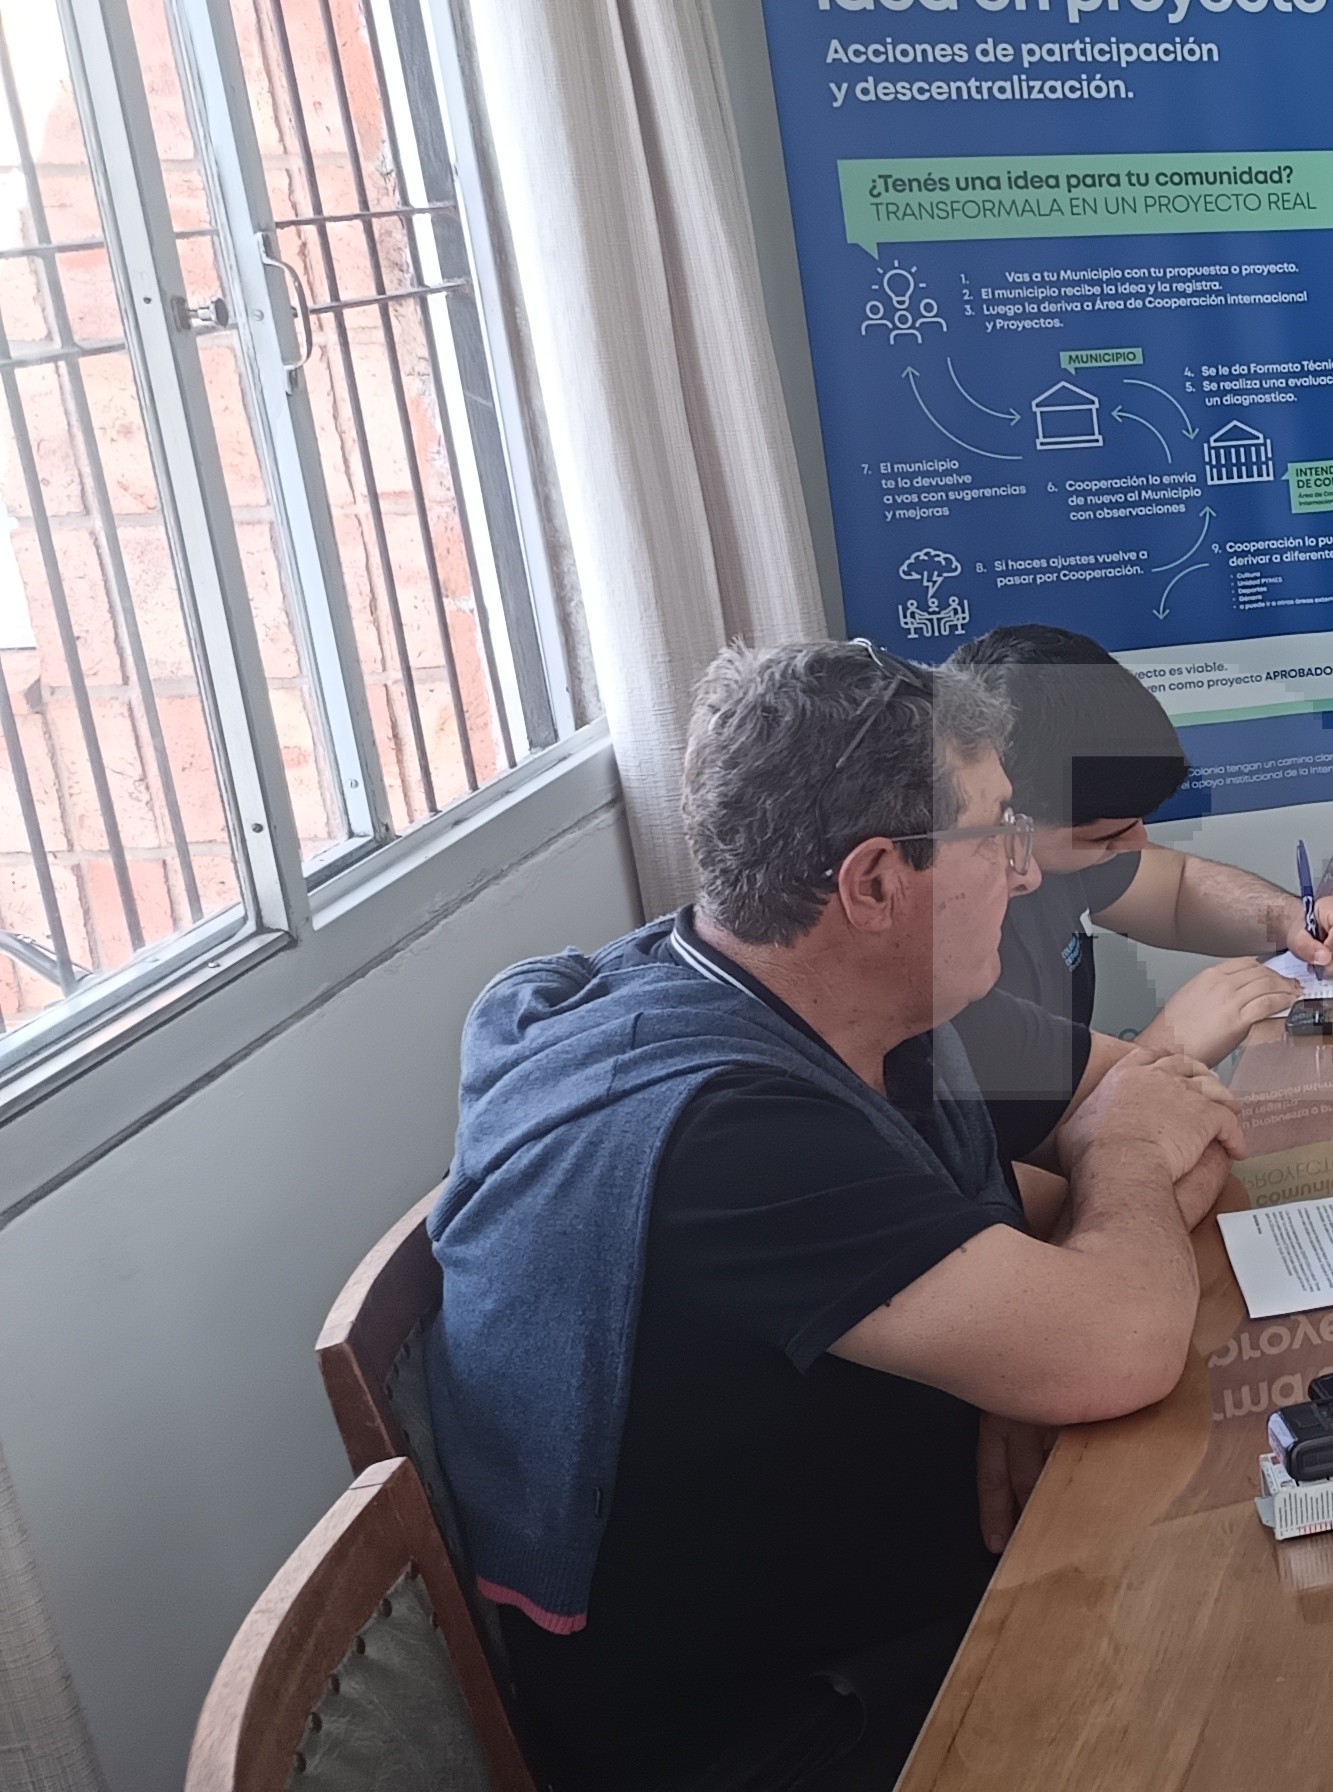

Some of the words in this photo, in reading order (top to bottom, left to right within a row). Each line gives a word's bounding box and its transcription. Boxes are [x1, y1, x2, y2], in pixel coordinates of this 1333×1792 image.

[825, 37, 969, 63] Acciones
[975, 37, 1014, 63] de
[1021, 37, 1219, 68] participación
[829, 82, 848, 107] y
[855, 74, 1134, 101] descentralización.
[869, 172, 950, 198] ¿Tenés
[955, 173, 1001, 191] una
[1007, 170, 1060, 190] idea
[1067, 171, 1120, 193] para
[1125, 169, 1150, 187] tu
[1155, 165, 1294, 187] comunidad?
[870, 199, 1065, 221] TRANSFORMALA
[1070, 197, 1098, 216] EN
[1104, 196, 1137, 215] UN
[1144, 193, 1262, 214] PROYECTO
[1268, 192, 1317, 210] REAL
[960, 273, 970, 284] 1.
[1005, 271, 1031, 283] Vas
[1032, 273, 1042, 282] a
[1043, 270, 1057, 281] tu
[1060, 267, 1123, 281] Municipio
[1124, 268, 1149, 278] con
[1150, 267, 1164, 277] tu
[1166, 265, 1229, 279] propuesta
[1231, 265, 1240, 274] o
[1241, 262, 1299, 276] proyecto.
[962, 289, 973, 300] 2.
[981, 288, 992, 299] El
[994, 285, 1059, 300] municipio
[1061, 282, 1101, 295] recibe
[1103, 283, 1116, 294] la
[1117, 282, 1146, 294] idea
[1148, 283, 1156, 295] y
[1157, 281, 1170, 292] la
[1172, 279, 1223, 294] registra.
[964, 305, 975, 316] 3.
[983, 302, 1023, 316] Luego
[1025, 301, 1038, 314] la
[1040, 299, 1081, 312] deriva
[1083, 302, 1092, 311] a
[1094, 296, 1125, 310] Área
[1126, 297, 1143, 309] de
[1145, 294, 1226, 309] Cooperación
[985, 321, 994, 333] y
[996, 316, 1064, 331] Proyectos.
[1068, 351, 1137, 365] MUNICIPIO
[1184, 366, 1194, 377] 4.
[1201, 365, 1216, 376] Se
[1218, 364, 1229, 375] le
[1231, 363, 1248, 375] da
[1250, 361, 1301, 374] Formato
[1185, 382, 1196, 392] 5.
[1202, 380, 1218, 391] Se
[1219, 378, 1260, 390] realiza
[1262, 378, 1286, 388] una
[1205, 396, 1221, 406] un
[1222, 391, 1298, 406] diagnostico.
[861, 464, 872, 475] 7.
[880, 462, 891, 474] El
[893, 458, 959, 473] municipio
[881, 478, 895, 489] te
[897, 477, 911, 488] lo
[912, 473, 972, 488] devuelve
[1047, 482, 1058, 492] 6.
[1065, 475, 1147, 492] Cooperación
[1148, 474, 1161, 485] lo
[1296, 479, 1313, 489] DE
[883, 495, 893, 504] a
[895, 493, 919, 503] vos
[921, 491, 946, 502] con
[948, 484, 1027, 501] sugerencias
[1068, 495, 1085, 506] de
[1087, 493, 1125, 504] nuevo
[1126, 489, 1139, 501] al
[1141, 487, 1202, 500] Municipio
[885, 510, 894, 522] y
[895, 505, 950, 520] mejoras
[1069, 510, 1094, 521] con
[1096, 503, 1186, 518] observaciones
[1212, 544, 1222, 554] 9.
[1226, 537, 1304, 553] Cooperación
[1305, 535, 1316, 547] lo
[976, 562, 987, 573] 8.
[994, 560, 1006, 571] Si
[1008, 559, 1047, 571] haces
[1049, 554, 1096, 569] ajustes
[1097, 551, 1137, 563] vuelve
[1139, 550, 1148, 559] a
[1229, 554, 1270, 567] derivar
[1272, 553, 1281, 563] a
[997, 574, 1034, 588] pasar
[1036, 572, 1058, 584] por
[1060, 565, 1144, 581] Cooperación.
[1168, 666, 1183, 676] es
[1185, 662, 1228, 674] viable.
[1168, 679, 1204, 691] como
[1207, 674, 1263, 689] proyecto
[1226, 762, 1262, 774] tengan
[1264, 760, 1276, 769] un
[1278, 755, 1314, 767] camino
[1192, 778, 1225, 789] apoyo
[1226, 768, 1283, 784] institucional
[1284, 766, 1298, 778] de
[1299, 765, 1309, 776] la
